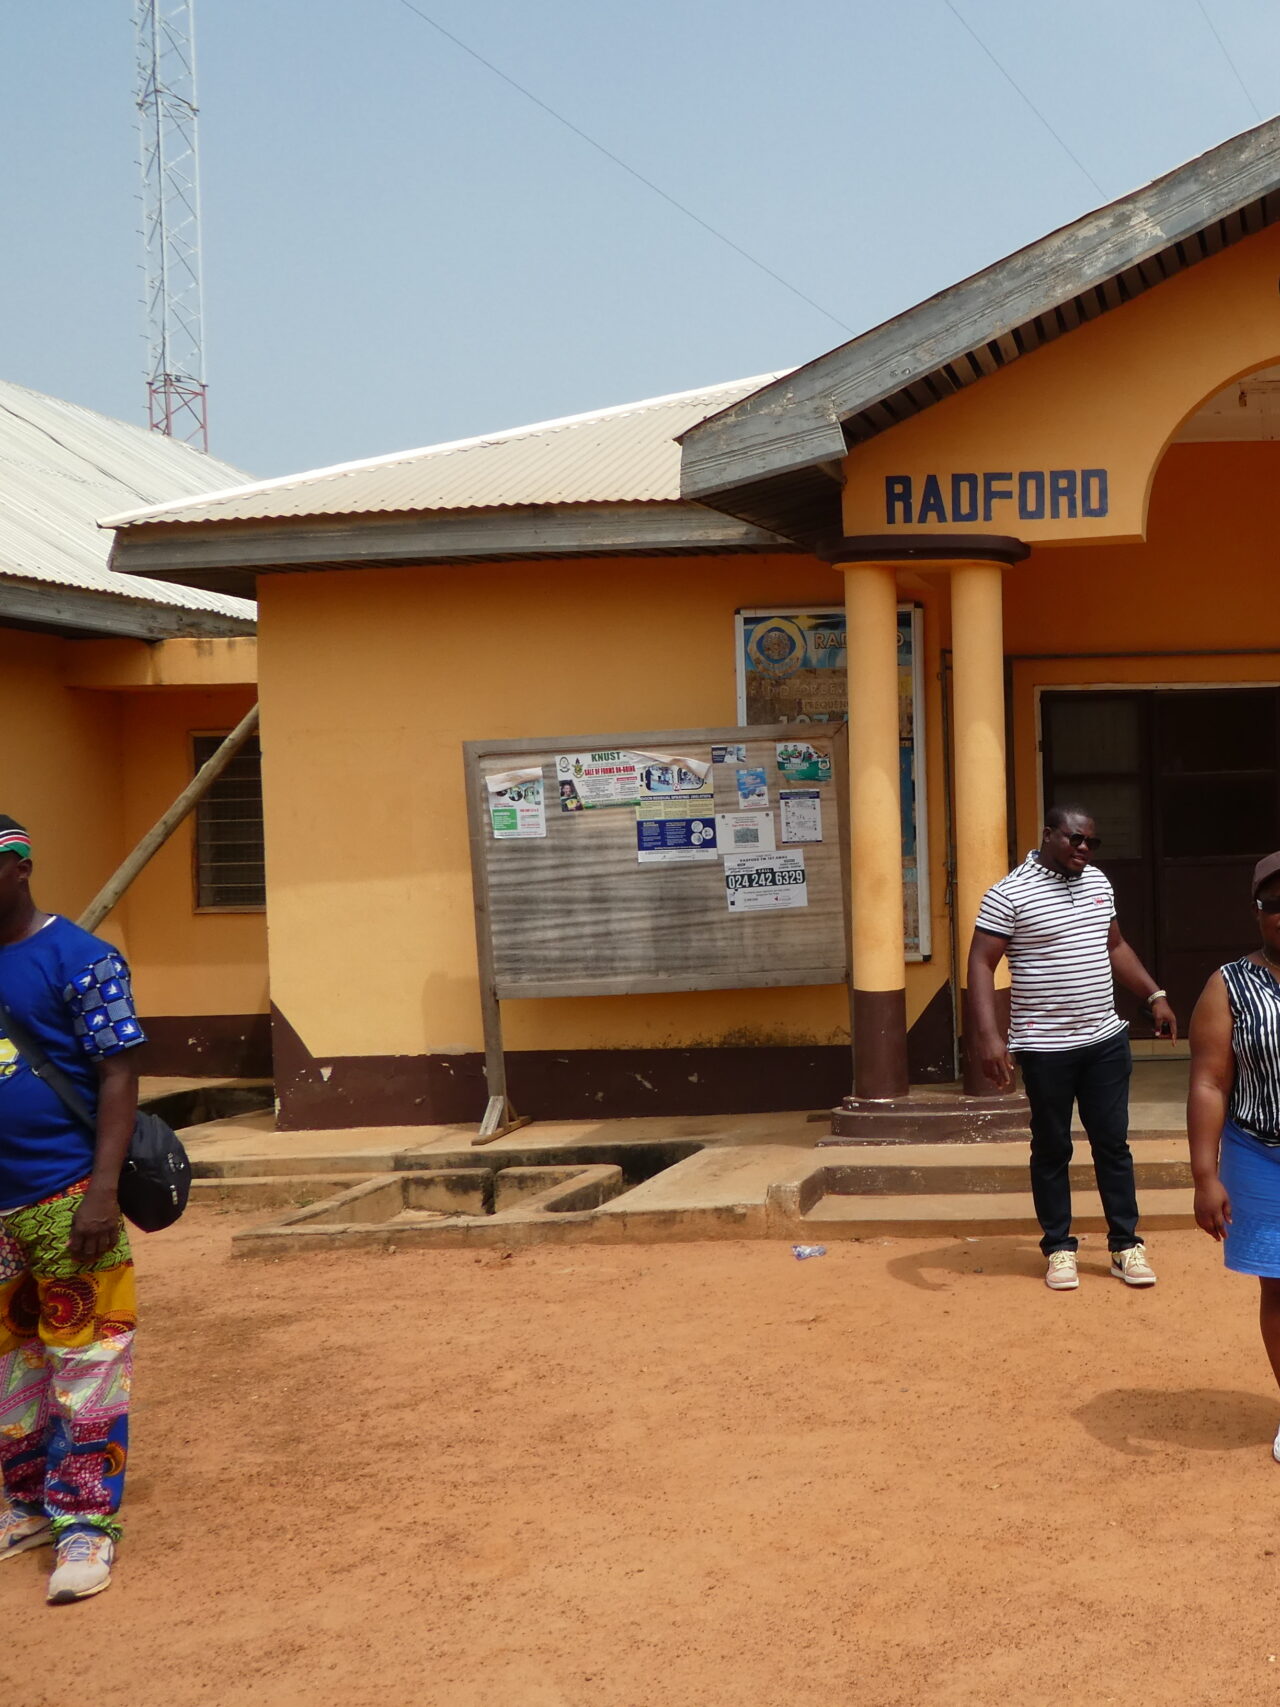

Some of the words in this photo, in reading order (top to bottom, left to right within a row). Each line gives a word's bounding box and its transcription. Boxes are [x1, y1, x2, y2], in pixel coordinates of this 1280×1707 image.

[885, 468, 1109, 525] RADFORD
[591, 751, 622, 763] KNUST
[728, 875, 750, 889] 024
[752, 872, 773, 887] 242
[775, 870, 804, 885] 6329
